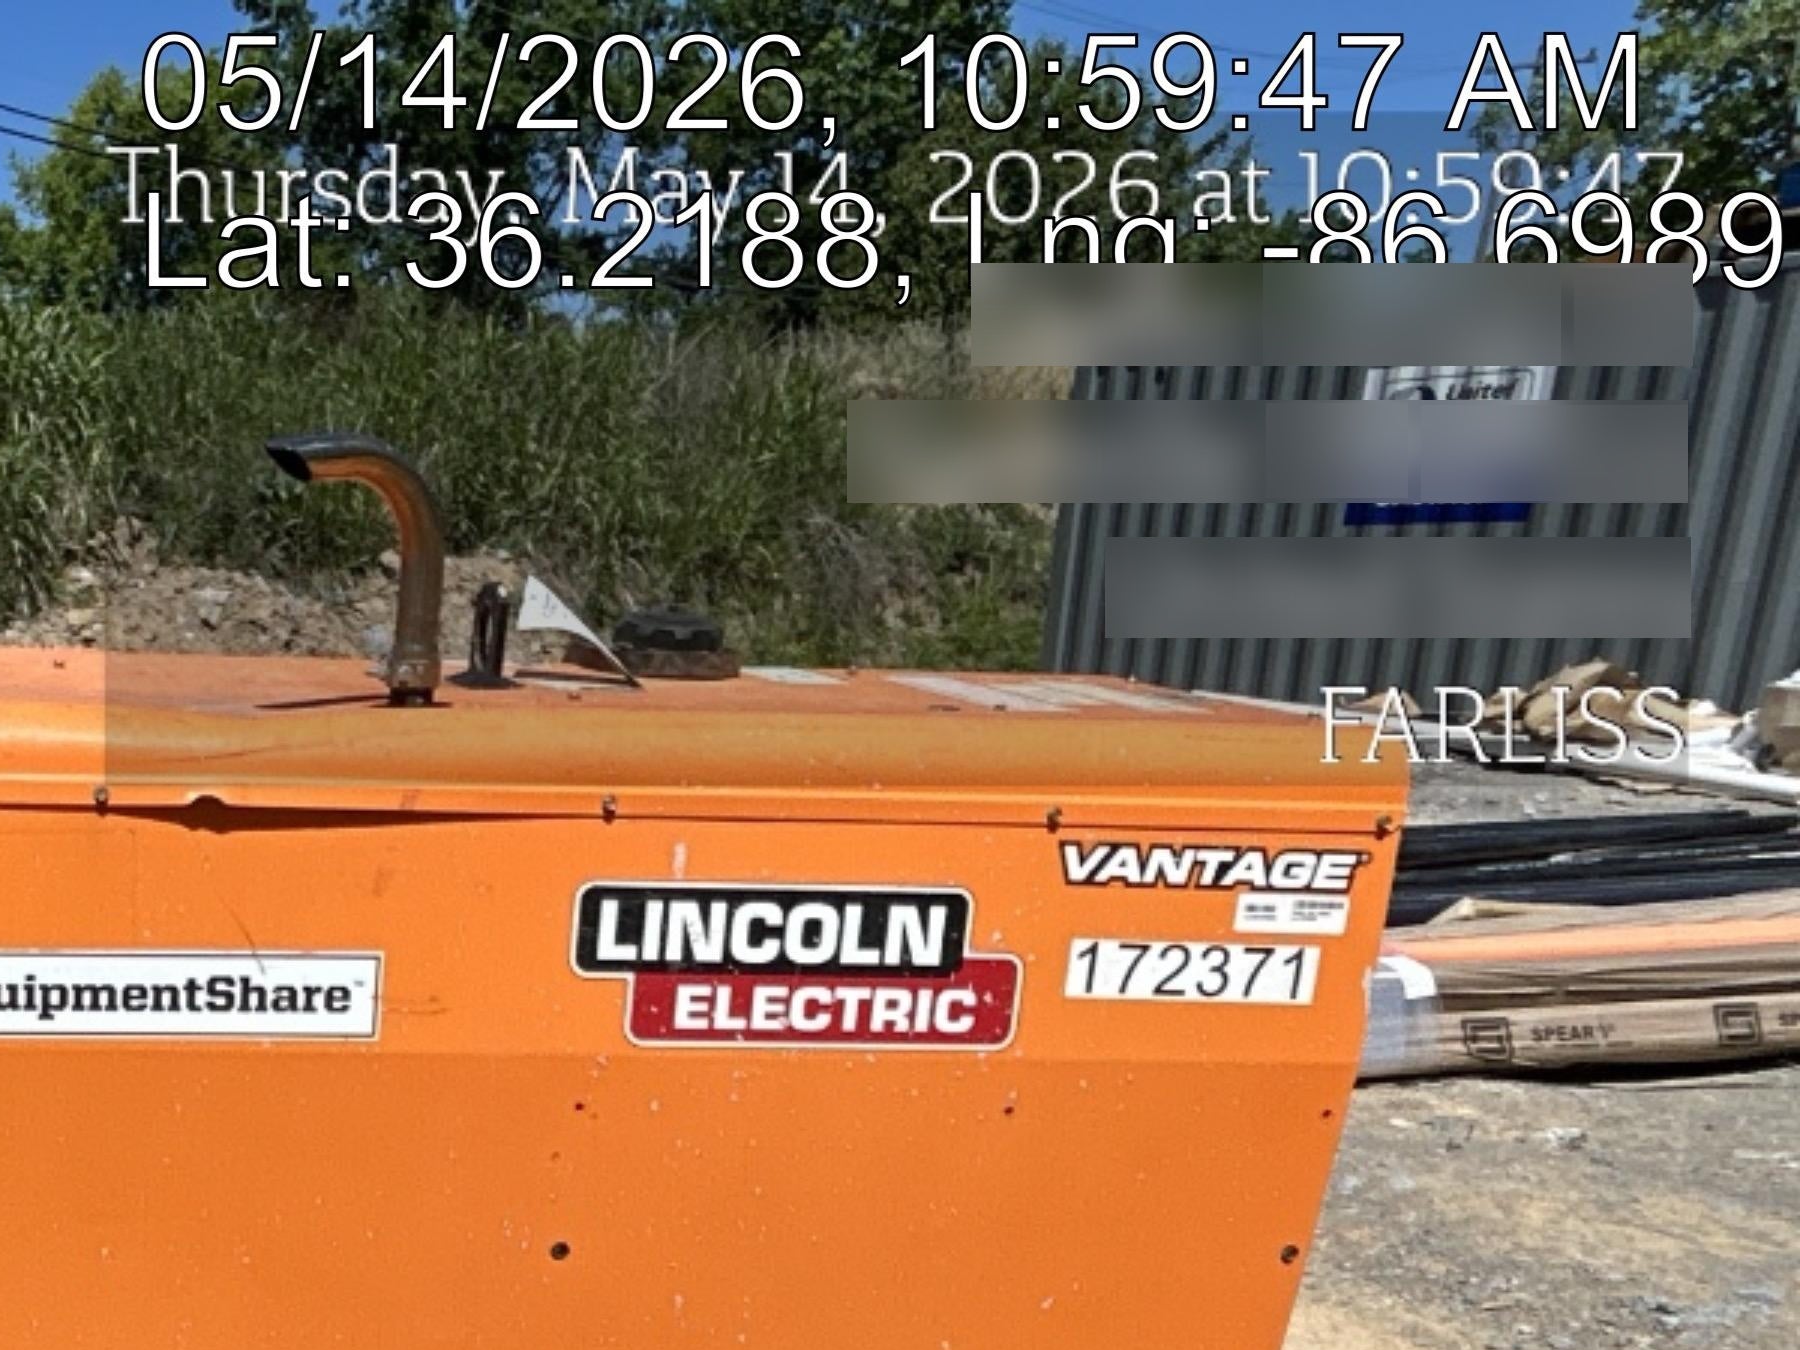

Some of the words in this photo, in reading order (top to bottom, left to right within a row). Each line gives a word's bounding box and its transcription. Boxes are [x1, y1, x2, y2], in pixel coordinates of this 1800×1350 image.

[1060, 842, 1360, 891] VANTAGE
[595, 898, 948, 968] LINCOLN
[1076, 941, 1310, 1001] 172371
[672, 984, 977, 1034] ELECTRIC
